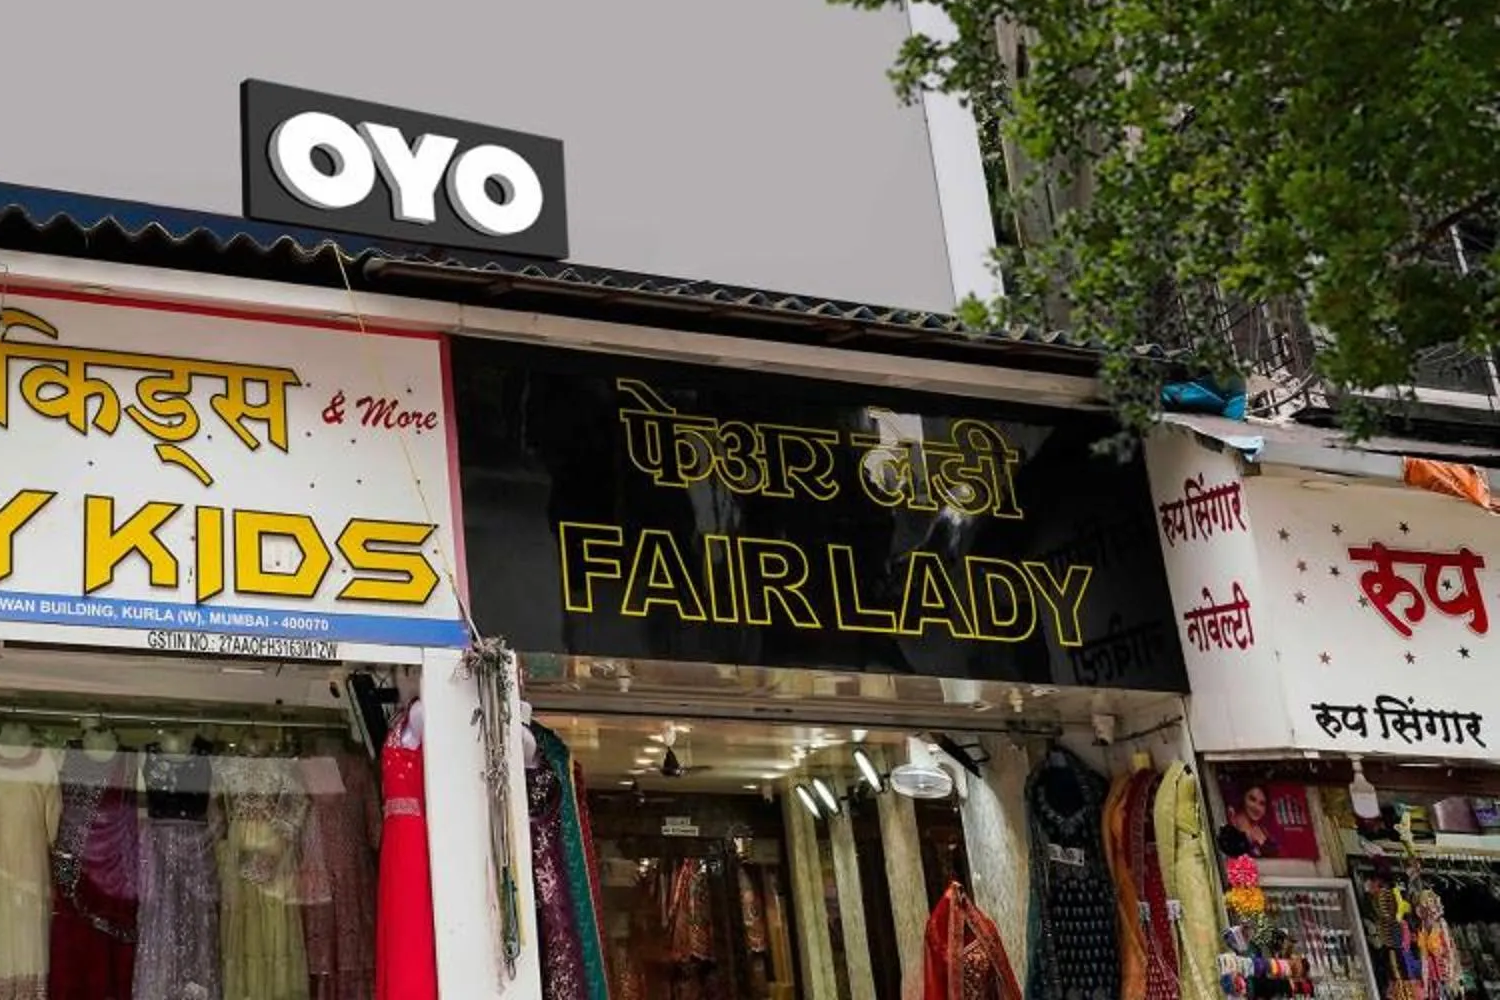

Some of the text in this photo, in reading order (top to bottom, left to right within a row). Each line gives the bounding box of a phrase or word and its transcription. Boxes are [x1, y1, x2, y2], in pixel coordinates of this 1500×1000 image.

[266, 112, 543, 237] OYO
[321, 388, 438, 430] & More
[84, 495, 440, 604] KIDS
[560, 521, 822, 628] FAIR
[828, 544, 1092, 647] LADY
[41, 601, 118, 619] BUILDING,
[122, 606, 173, 623] KURLA
[209, 614, 269, 629] MUMBAI
[282, 616, 329, 631] 400070
[147, 631, 186, 649] GSTIN
[1373, 695, 1487, 748] सिंगार
